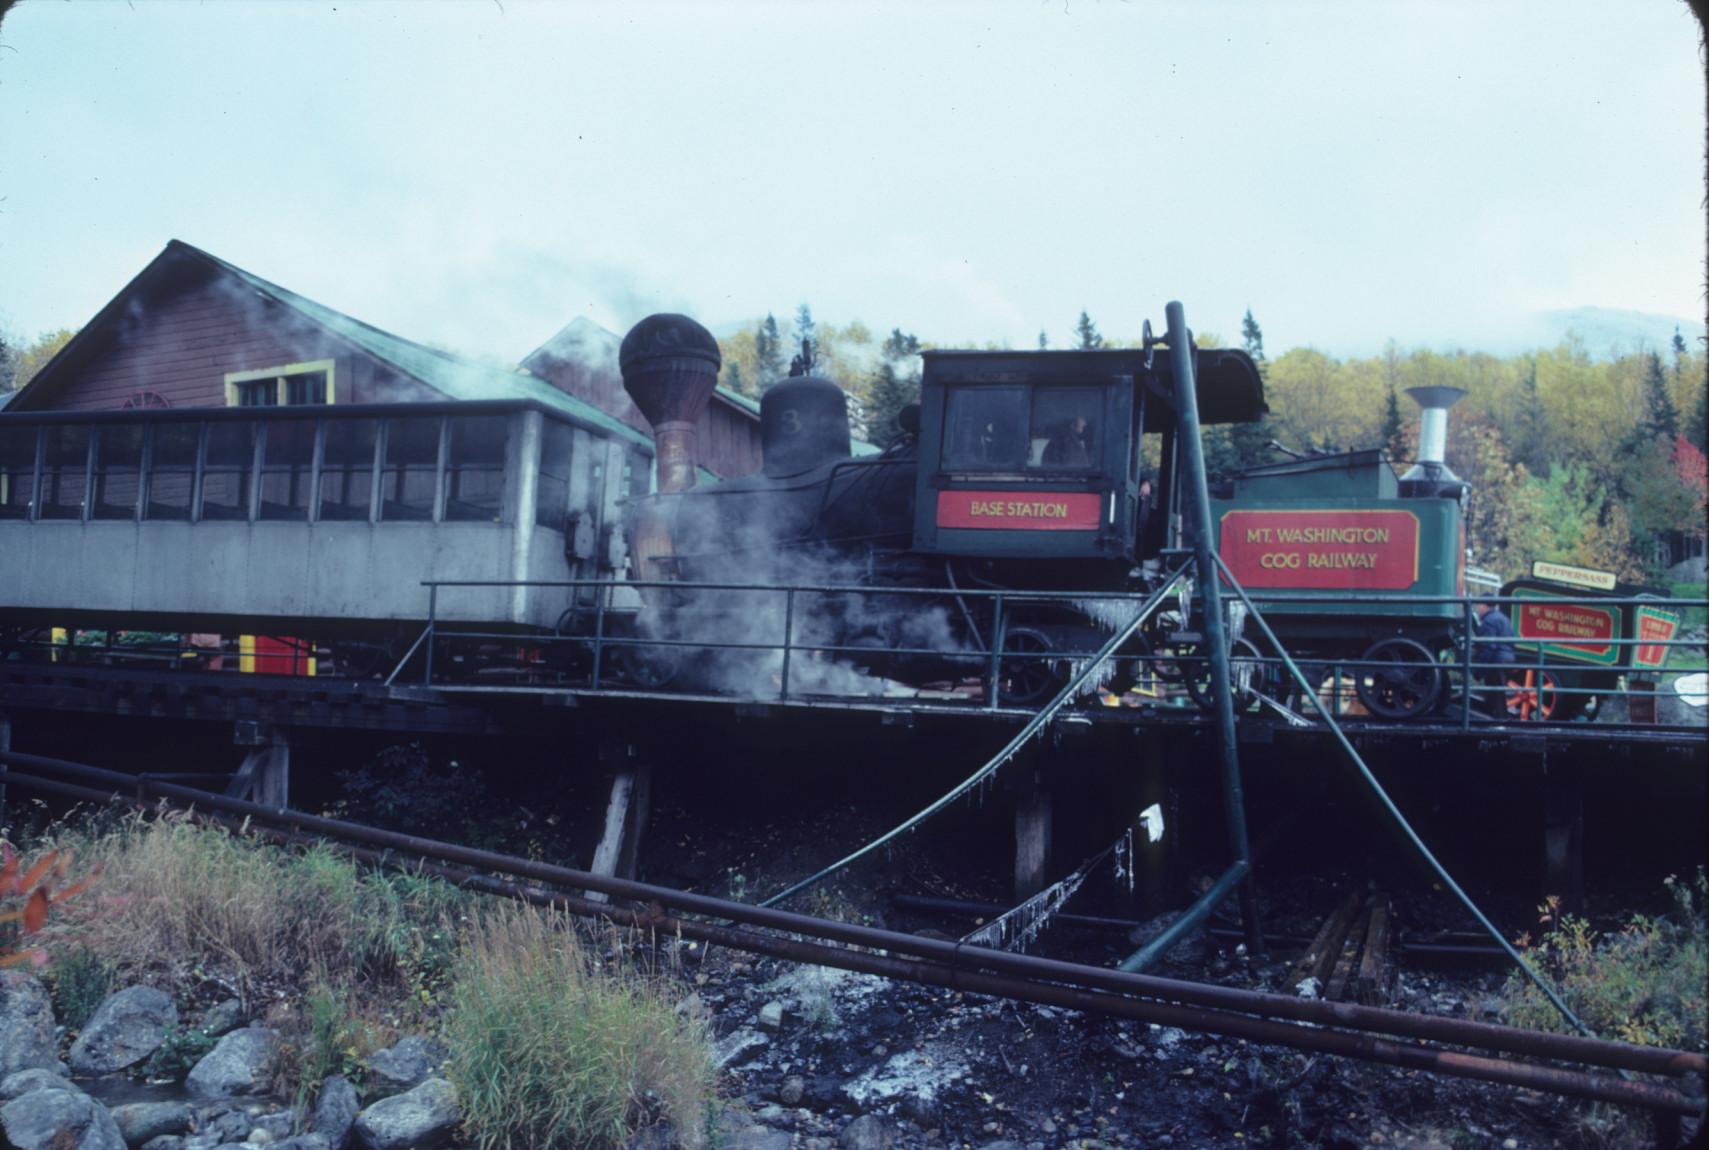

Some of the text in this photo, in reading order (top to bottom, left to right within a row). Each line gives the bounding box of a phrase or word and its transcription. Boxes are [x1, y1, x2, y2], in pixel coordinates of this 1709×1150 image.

[781, 408, 801, 434] 3
[970, 501, 1068, 518] BASE STATION
[1247, 528, 1390, 543] MT. WASHINGTON
[1260, 553, 1378, 568] COG RAILWAY
[1538, 564, 1609, 585] PEPPERSASS
[1543, 608, 1604, 629] WASHINGTON
[1535, 619, 1597, 638] COG RAILWAY
